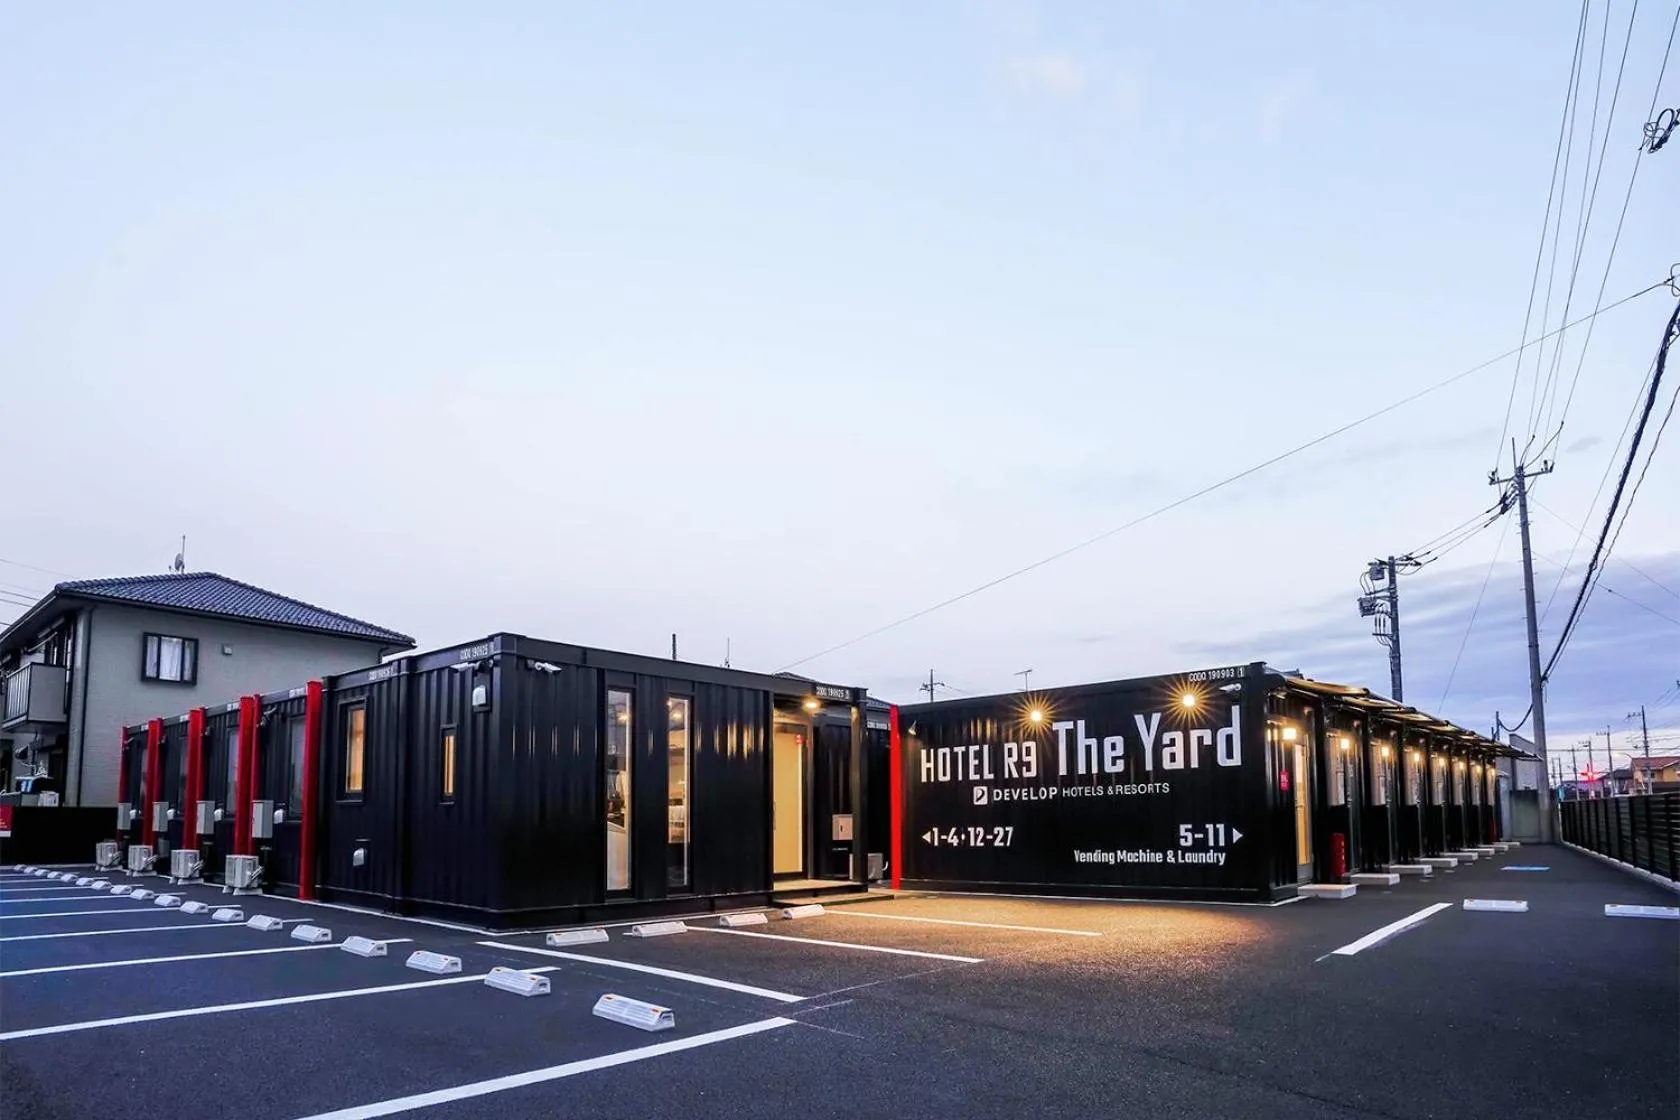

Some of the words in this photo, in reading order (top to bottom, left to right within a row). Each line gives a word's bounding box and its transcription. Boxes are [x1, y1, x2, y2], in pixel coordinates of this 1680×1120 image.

[1208, 668, 1235, 680] 190903
[920, 744, 994, 783] HOTEL
[1003, 740, 1037, 779] R9
[1053, 720, 1125, 775] The
[1133, 705, 1242, 772] Yard
[992, 787, 1058, 801] DEVELOP
[1062, 786, 1104, 797] HOTELS
[1179, 823, 1226, 847] 5-11
[1073, 850, 1115, 865] Vending
[1117, 850, 1163, 863] Machine
[1166, 851, 1176, 864] &
[1178, 850, 1226, 866] Laundry
